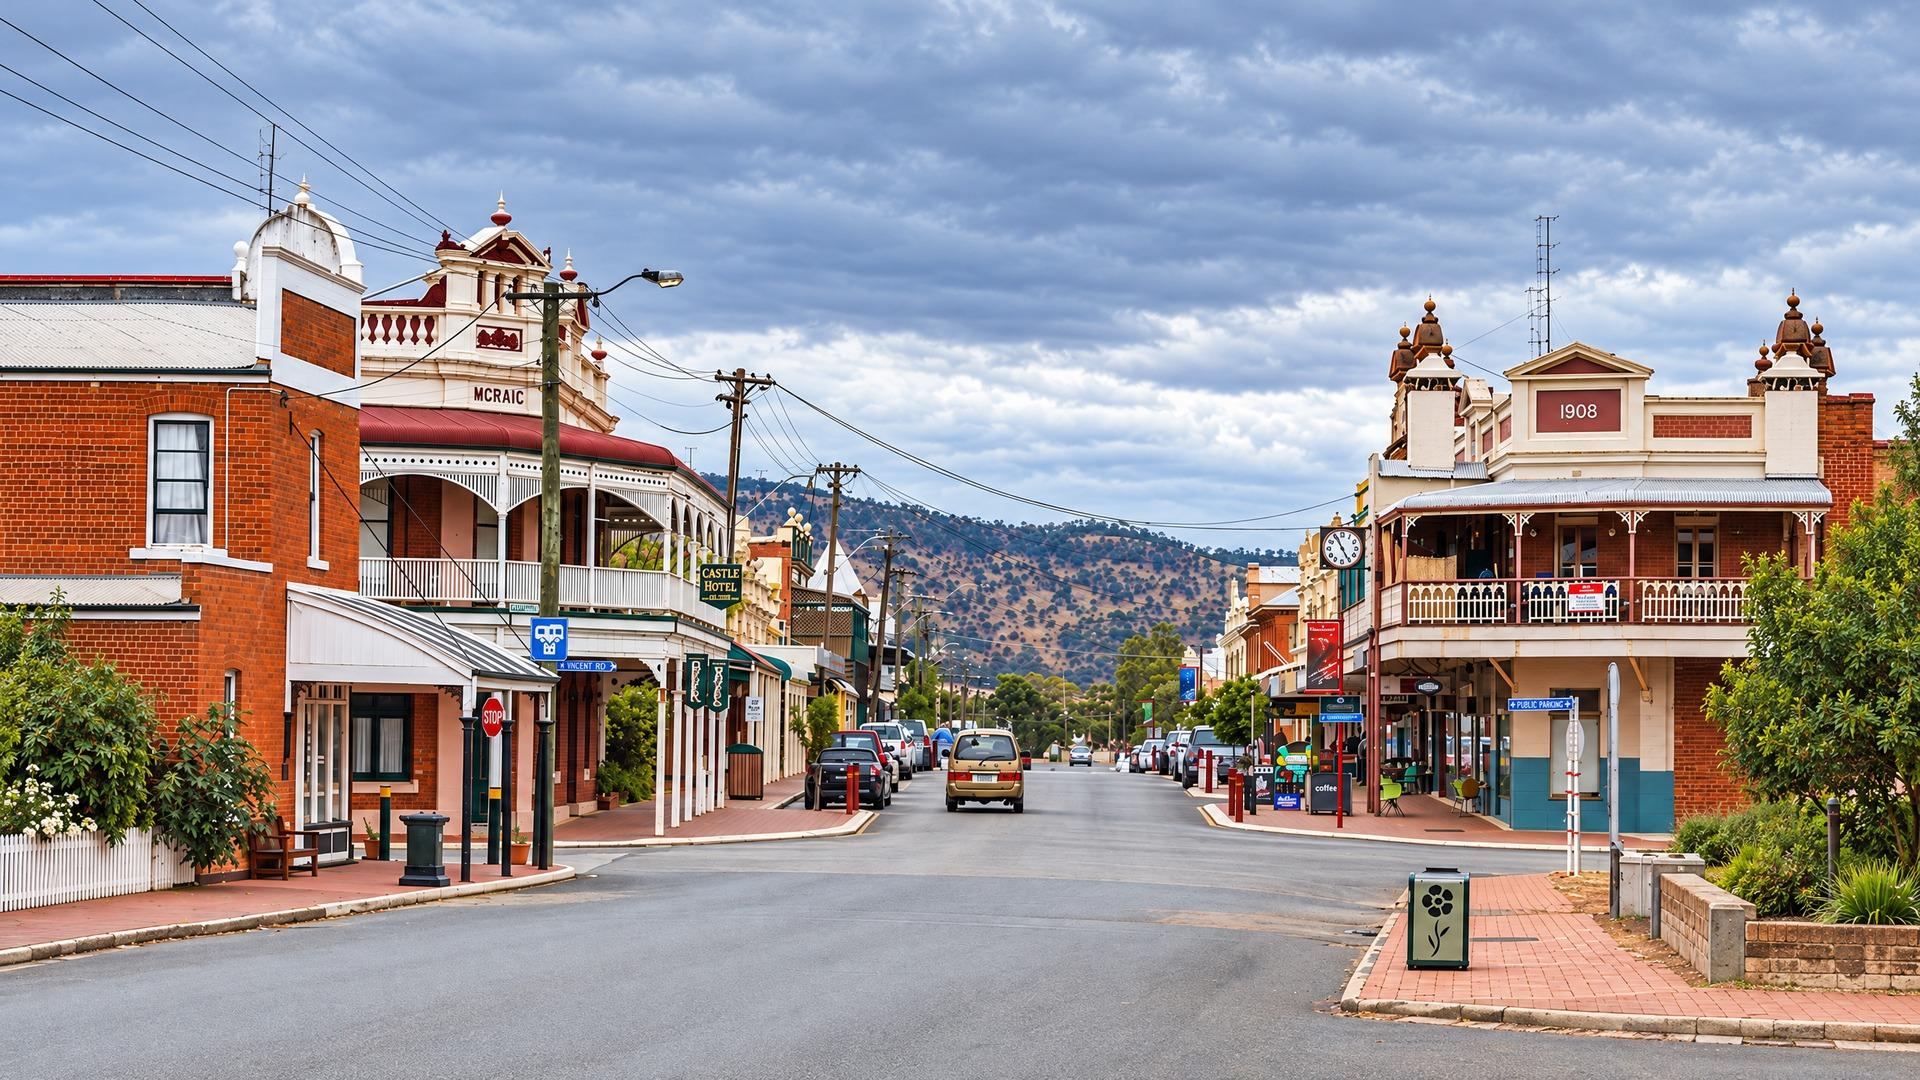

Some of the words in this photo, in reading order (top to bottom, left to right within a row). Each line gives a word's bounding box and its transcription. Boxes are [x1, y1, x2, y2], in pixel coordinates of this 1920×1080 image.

[473, 386, 525, 405] MCRAIC
[1560, 403, 1598, 419] 1908
[702, 568, 740, 579] CASTLE
[704, 581, 737, 592] HOTEL
[595, 662, 606, 670] RD
[1516, 701, 1538, 709] PUBLIC
[1538, 700, 1564, 709] PARKING
[484, 710, 503, 725] STOP
[1315, 784, 1338, 792] coffee
